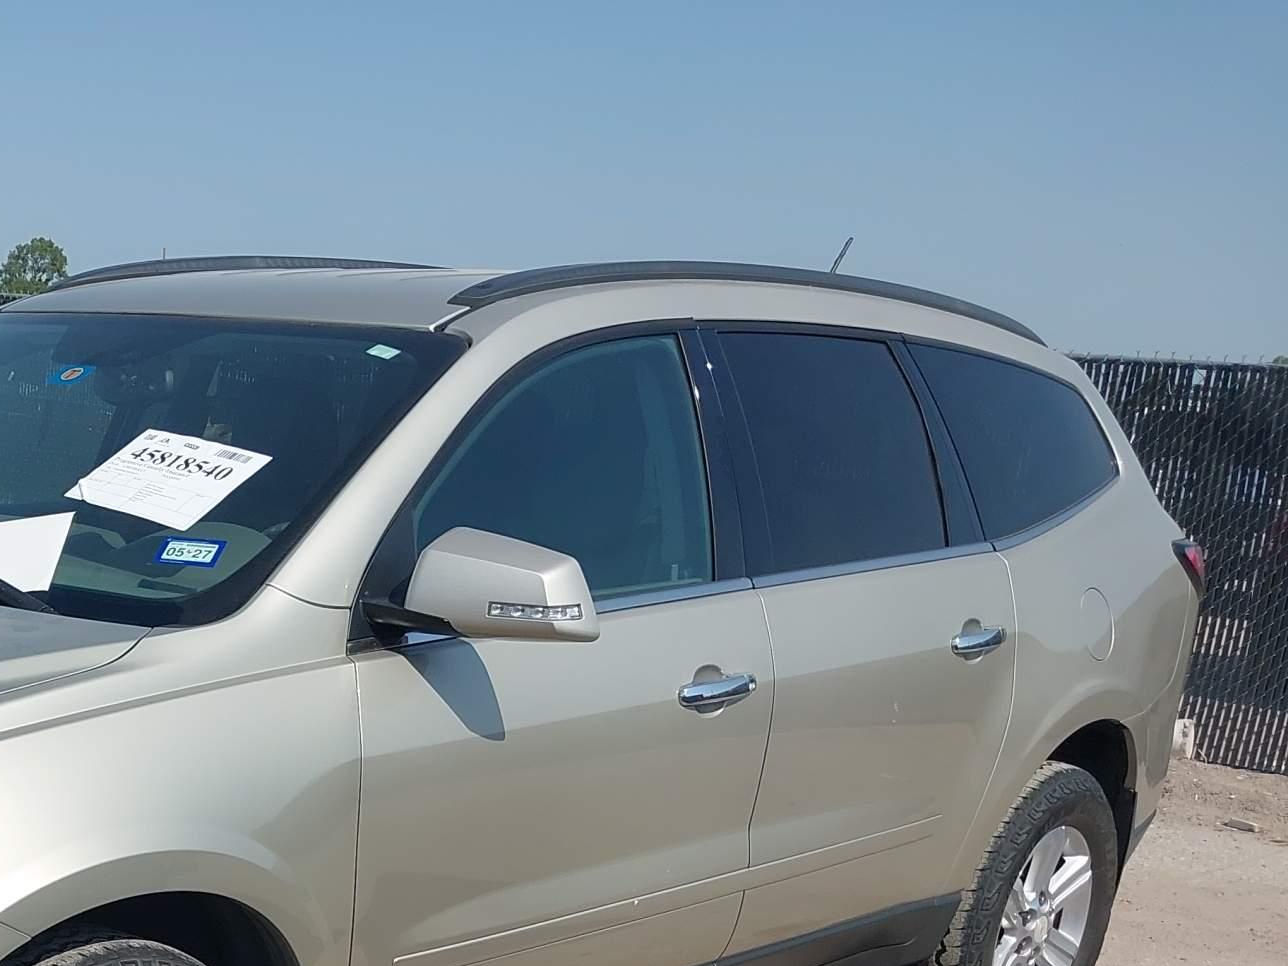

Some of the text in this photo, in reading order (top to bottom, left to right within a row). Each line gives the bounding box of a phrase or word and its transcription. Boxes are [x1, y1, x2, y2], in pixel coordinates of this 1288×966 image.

[130, 447, 234, 481] 45818540
[166, 547, 213, 560] 05 27
